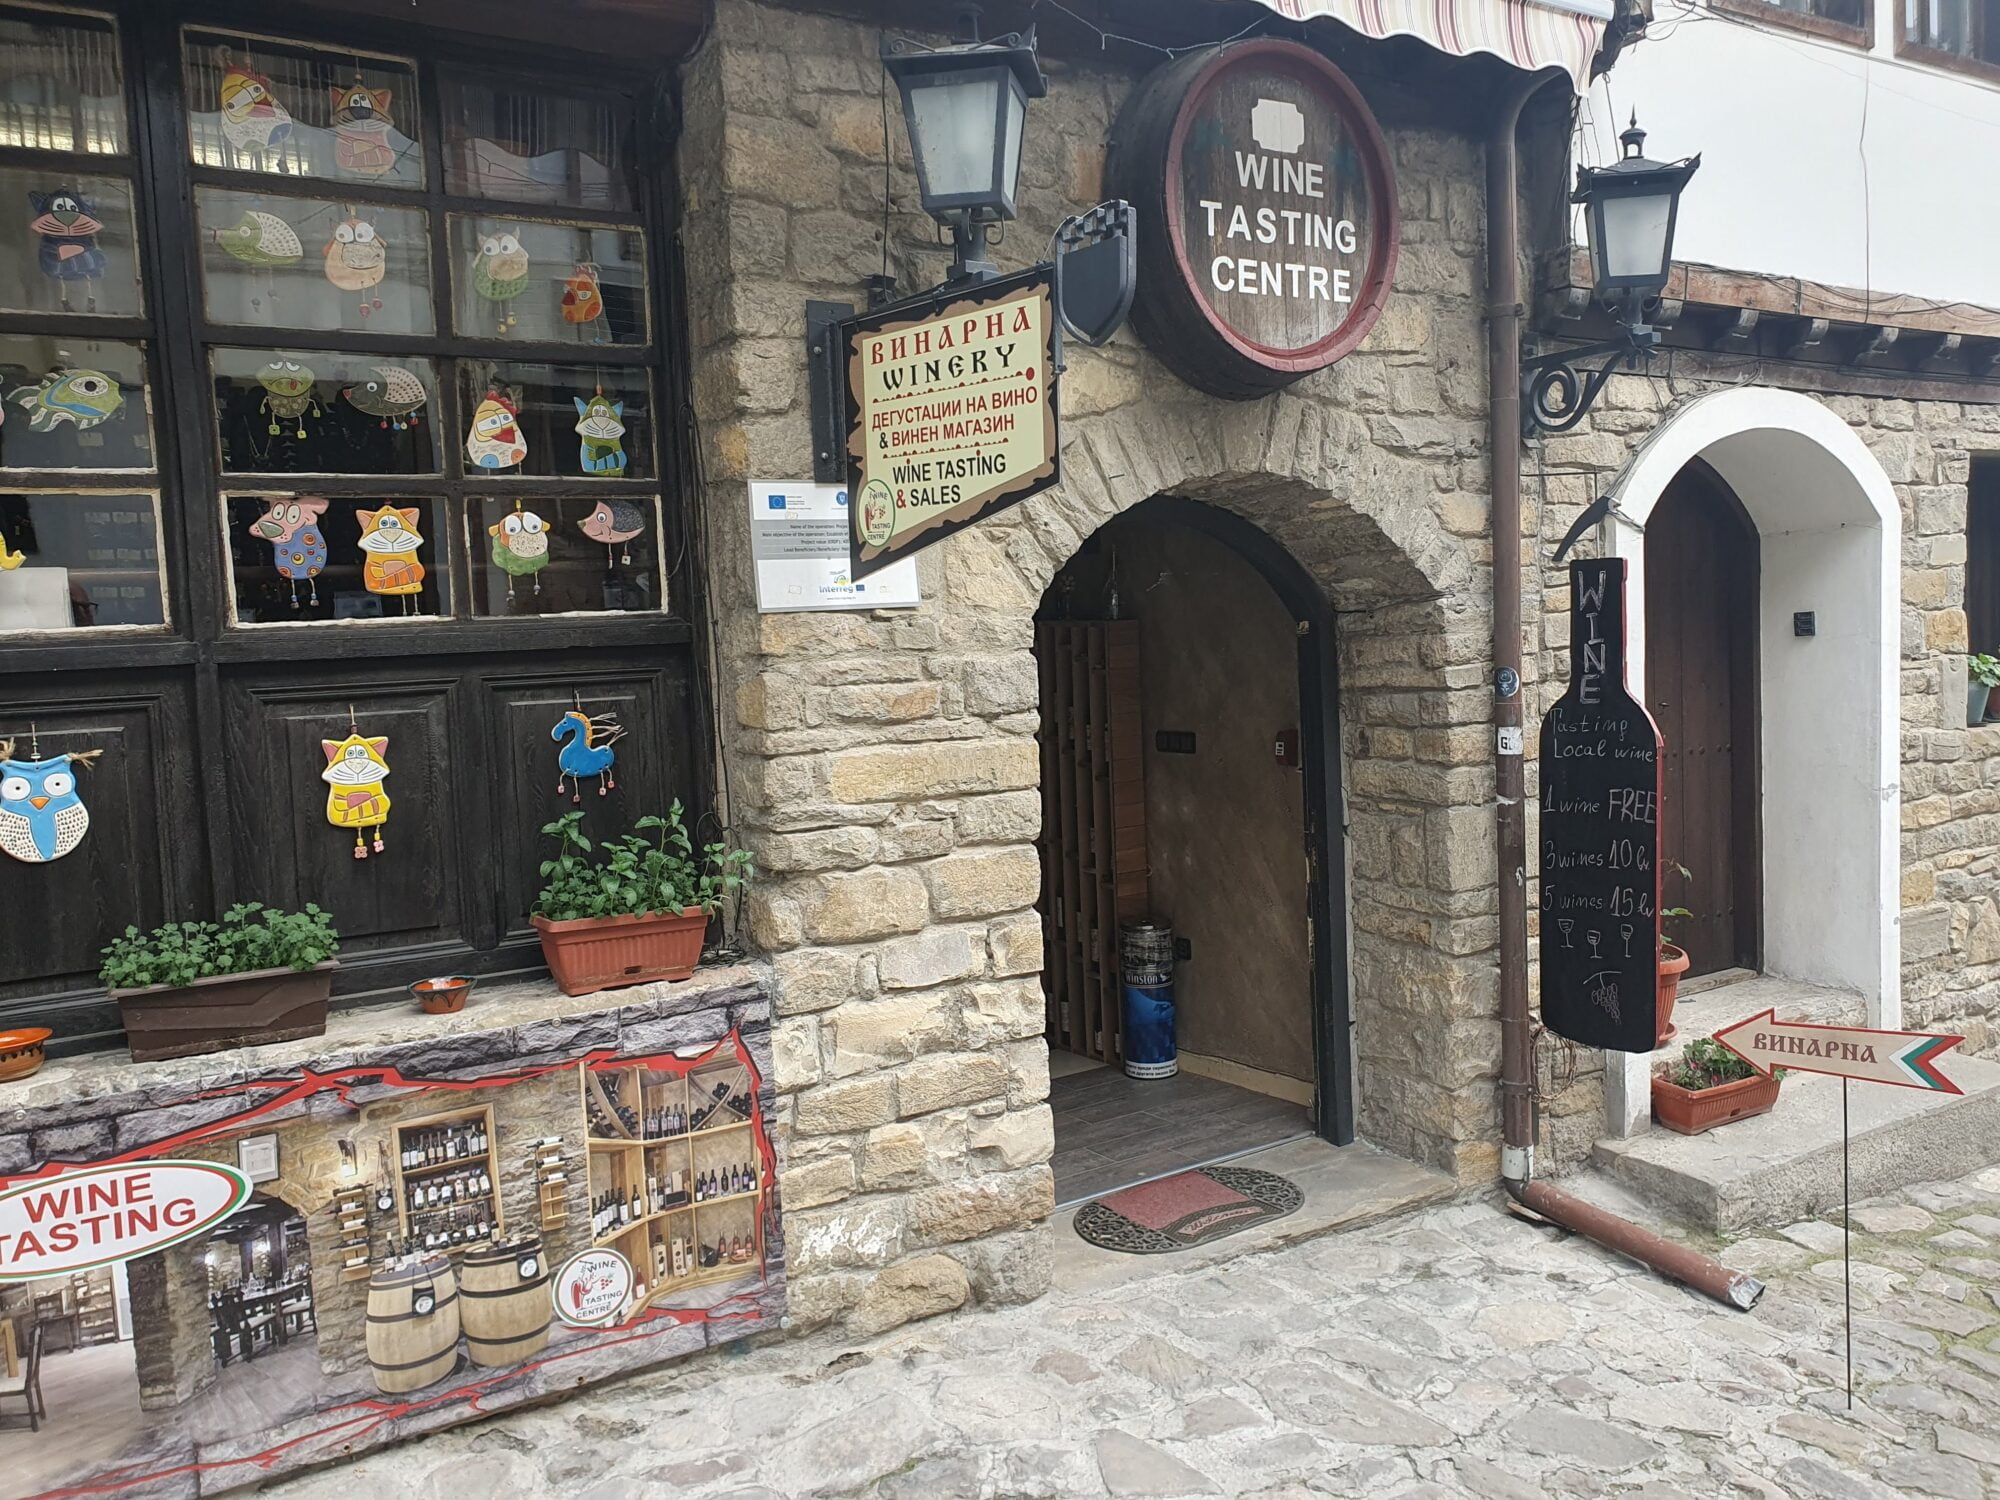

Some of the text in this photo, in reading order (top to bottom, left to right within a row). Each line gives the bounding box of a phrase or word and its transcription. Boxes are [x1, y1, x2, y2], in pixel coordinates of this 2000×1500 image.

[1235, 151, 1324, 198] WINE
[1200, 200, 1356, 254] TASTING
[1211, 255, 1351, 303] CENTRE
[870, 305, 1032, 366] ВИНАРНА
[882, 343, 1016, 391] WINERY
[871, 386, 1038, 433] ДЕГУСТАЦИИ НА ВИНО
[879, 413, 1015, 449] & ВИНЕН МАГАЗИН
[893, 453, 1007, 484] WINE TASTING
[872, 491, 888, 501] WINE
[896, 485, 961, 509] & SALES
[867, 533, 885, 541] CENTRE
[871, 522, 891, 530] TASTING
[1578, 570, 1607, 704] WINE
[1550, 708, 1628, 741] Tasting
[1554, 739, 1606, 759] Local
[1543, 784, 1657, 824] 1 wine FREE
[1545, 840, 1556, 869] 3
[1558, 851, 1603, 868] wines
[1608, 838, 1632, 869] 10
[1542, 884, 1556, 911] 5
[1561, 893, 1603, 910] wines
[1610, 885, 1634, 917] 15
[1126, 972, 1158, 985] Winston
[1752, 1032, 1878, 1064] ВИНАРНА
[22, 1172, 154, 1224] WINE
[587, 1260, 618, 1273] WINE
[576, 1303, 612, 1319] CENTRE
[586, 1290, 623, 1305] TASTING
